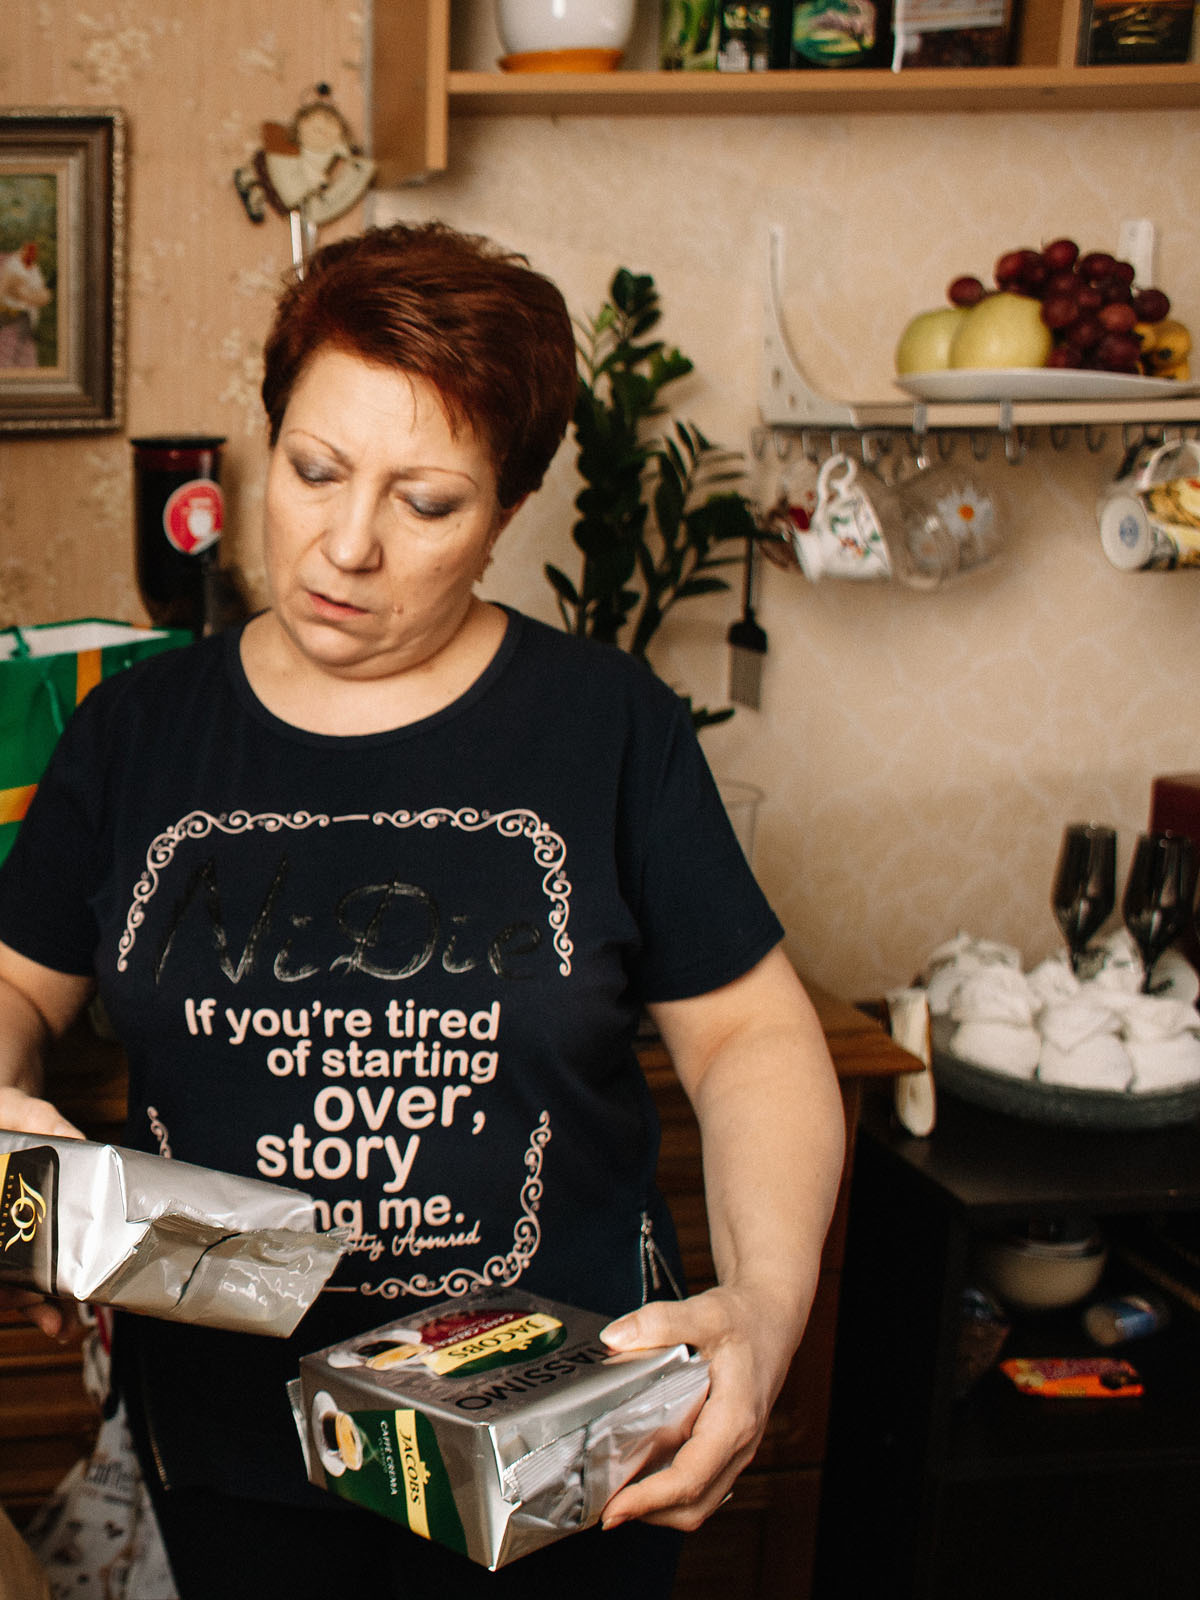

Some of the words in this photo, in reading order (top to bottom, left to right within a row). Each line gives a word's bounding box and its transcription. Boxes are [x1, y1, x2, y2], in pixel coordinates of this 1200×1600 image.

[184, 998, 217, 1036] If
[225, 999, 372, 1046] you're
[384, 998, 501, 1042] tired
[266, 1039, 312, 1078] of
[321, 1039, 499, 1084] starting
[313, 1084, 486, 1135] over,
[256, 1123, 421, 1193] story
[378, 1194, 465, 1231] me.
[447, 1319, 545, 1360] JACOBS
[398, 1429, 421, 1506] JACOBS
